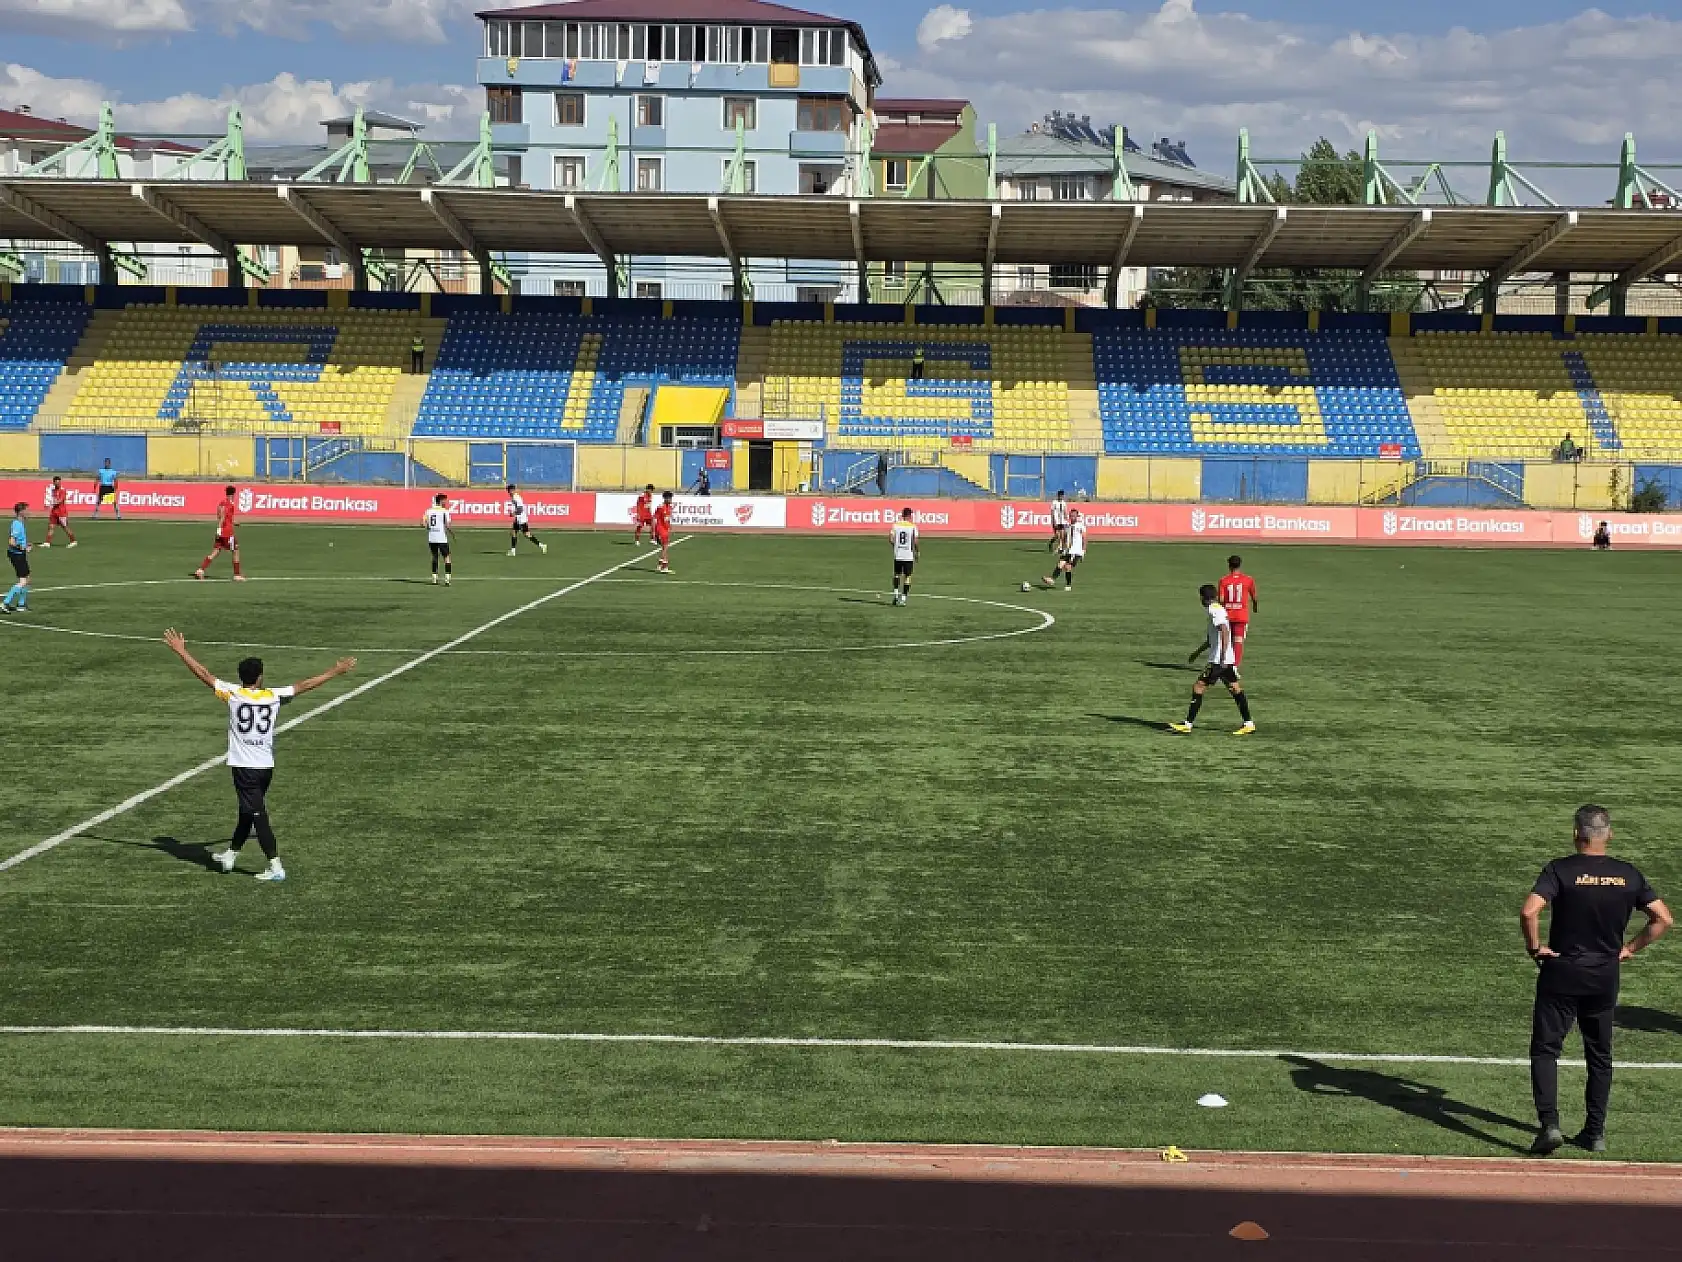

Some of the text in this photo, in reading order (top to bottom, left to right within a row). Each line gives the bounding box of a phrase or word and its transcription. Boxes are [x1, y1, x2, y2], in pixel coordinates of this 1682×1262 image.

[119, 491, 184, 507] Bankası
[255, 494, 378, 511] Ziraat Bankası
[449, 499, 569, 515] Ziraat Bnkası
[430, 514, 437, 527] 6
[828, 508, 880, 523] Ziraat
[1208, 514, 1330, 531] Ziraat Bankası
[1399, 516, 1524, 533] Ziraat Bankası
[899, 531, 906, 545] 8
[1227, 583, 1243, 602] 11
[237, 702, 272, 734] 93
